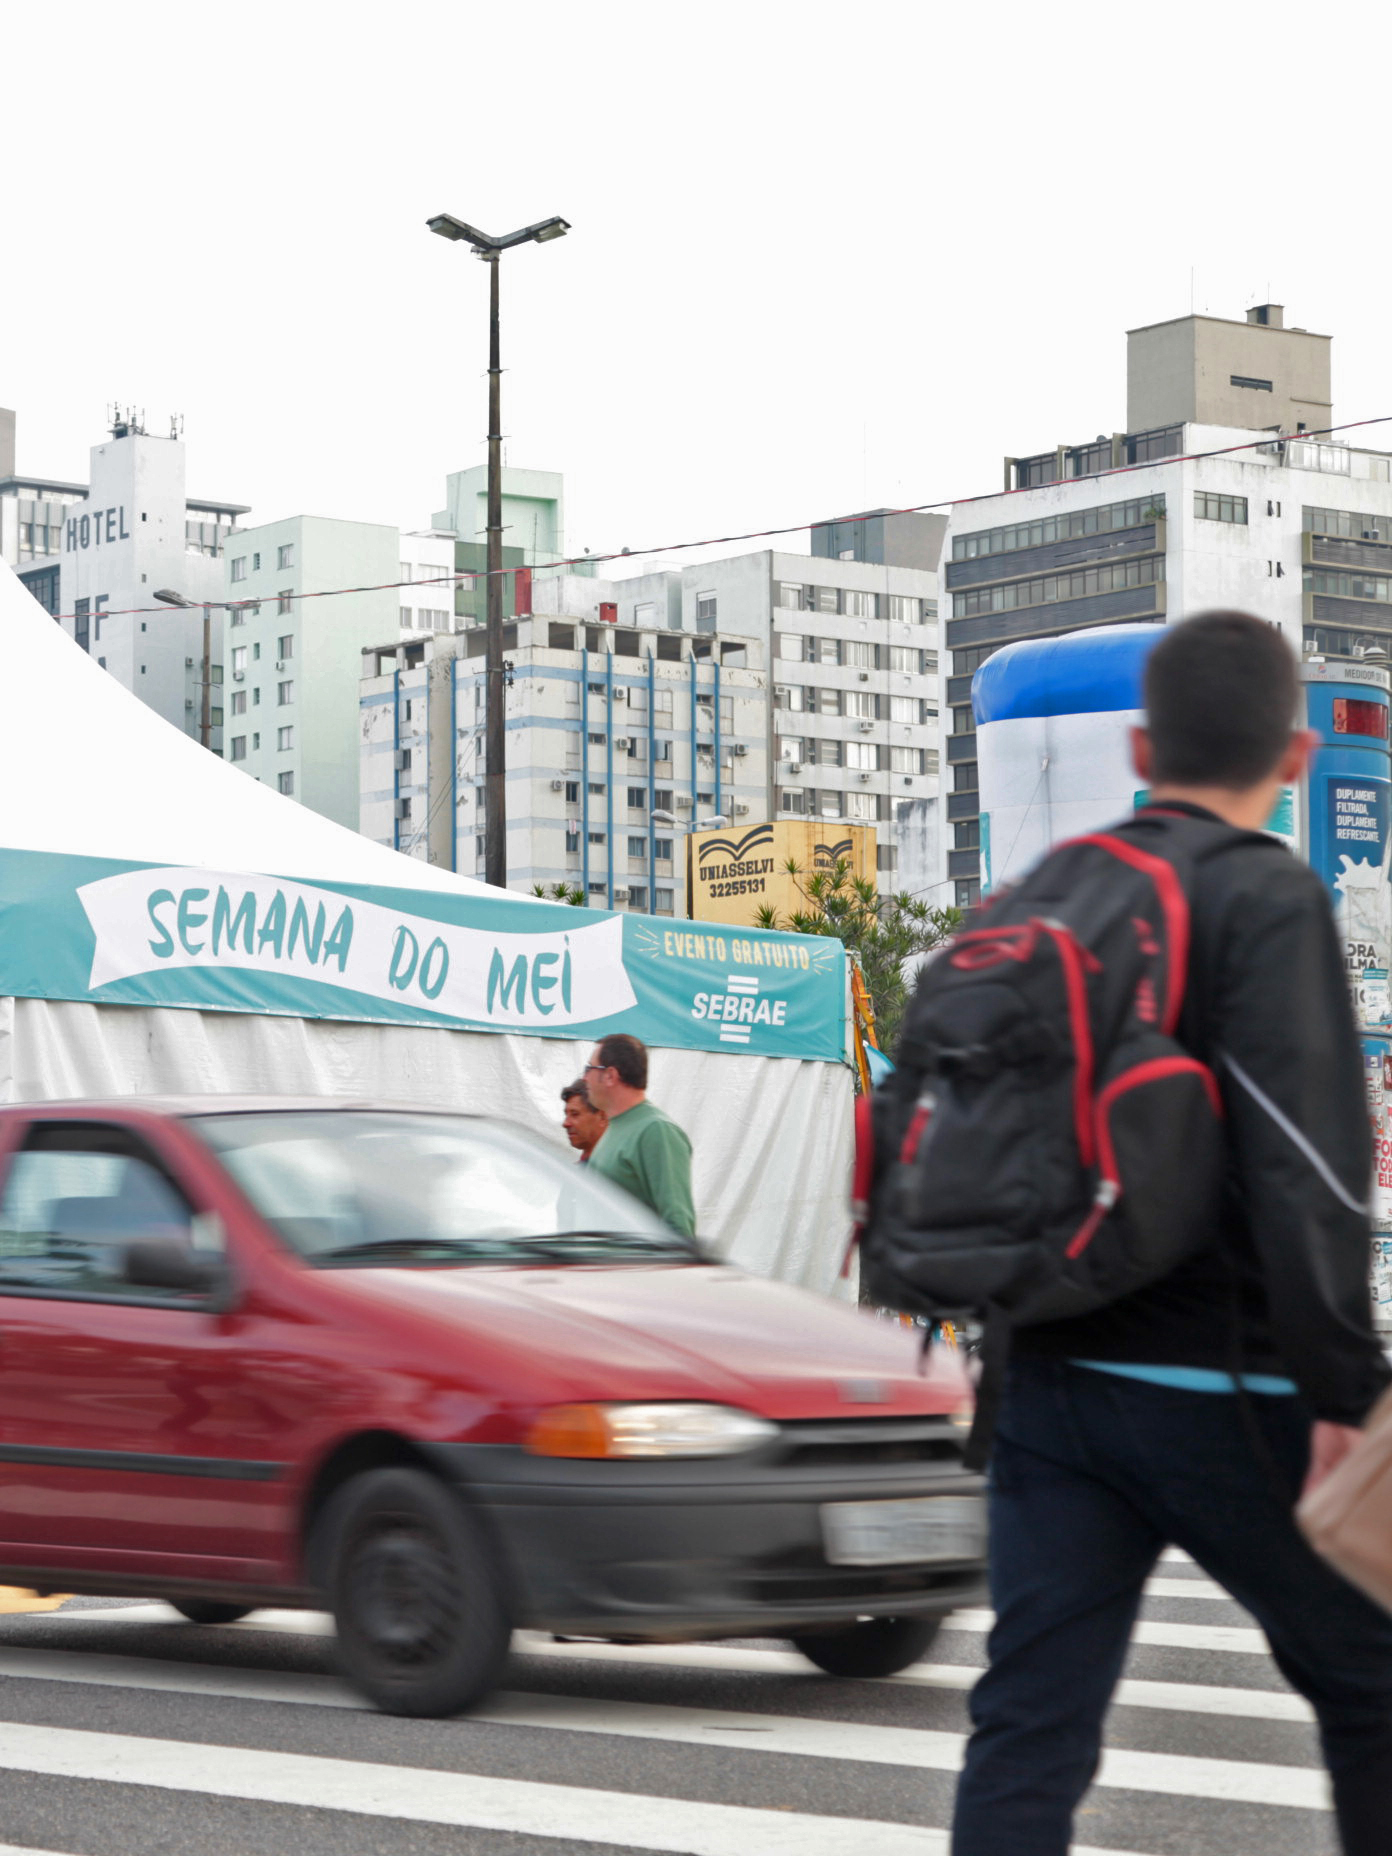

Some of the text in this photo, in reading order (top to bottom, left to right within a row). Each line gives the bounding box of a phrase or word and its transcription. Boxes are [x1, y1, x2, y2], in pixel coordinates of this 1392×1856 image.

[66, 505, 130, 552] HOTEL
[1336, 788, 1377, 802] DUPLAMENTE
[1336, 801, 1369, 815] FILTRADA,
[1336, 815, 1377, 829] DUPLAMENTE
[700, 858, 774, 881] UNIASSELVI
[710, 877, 765, 898] 32255131
[146, 884, 354, 974] SEMANA
[388, 924, 450, 1000] DO
[664, 931, 810, 970] EVENTO GRATUITO
[691, 992, 787, 1026] SEBRAE
